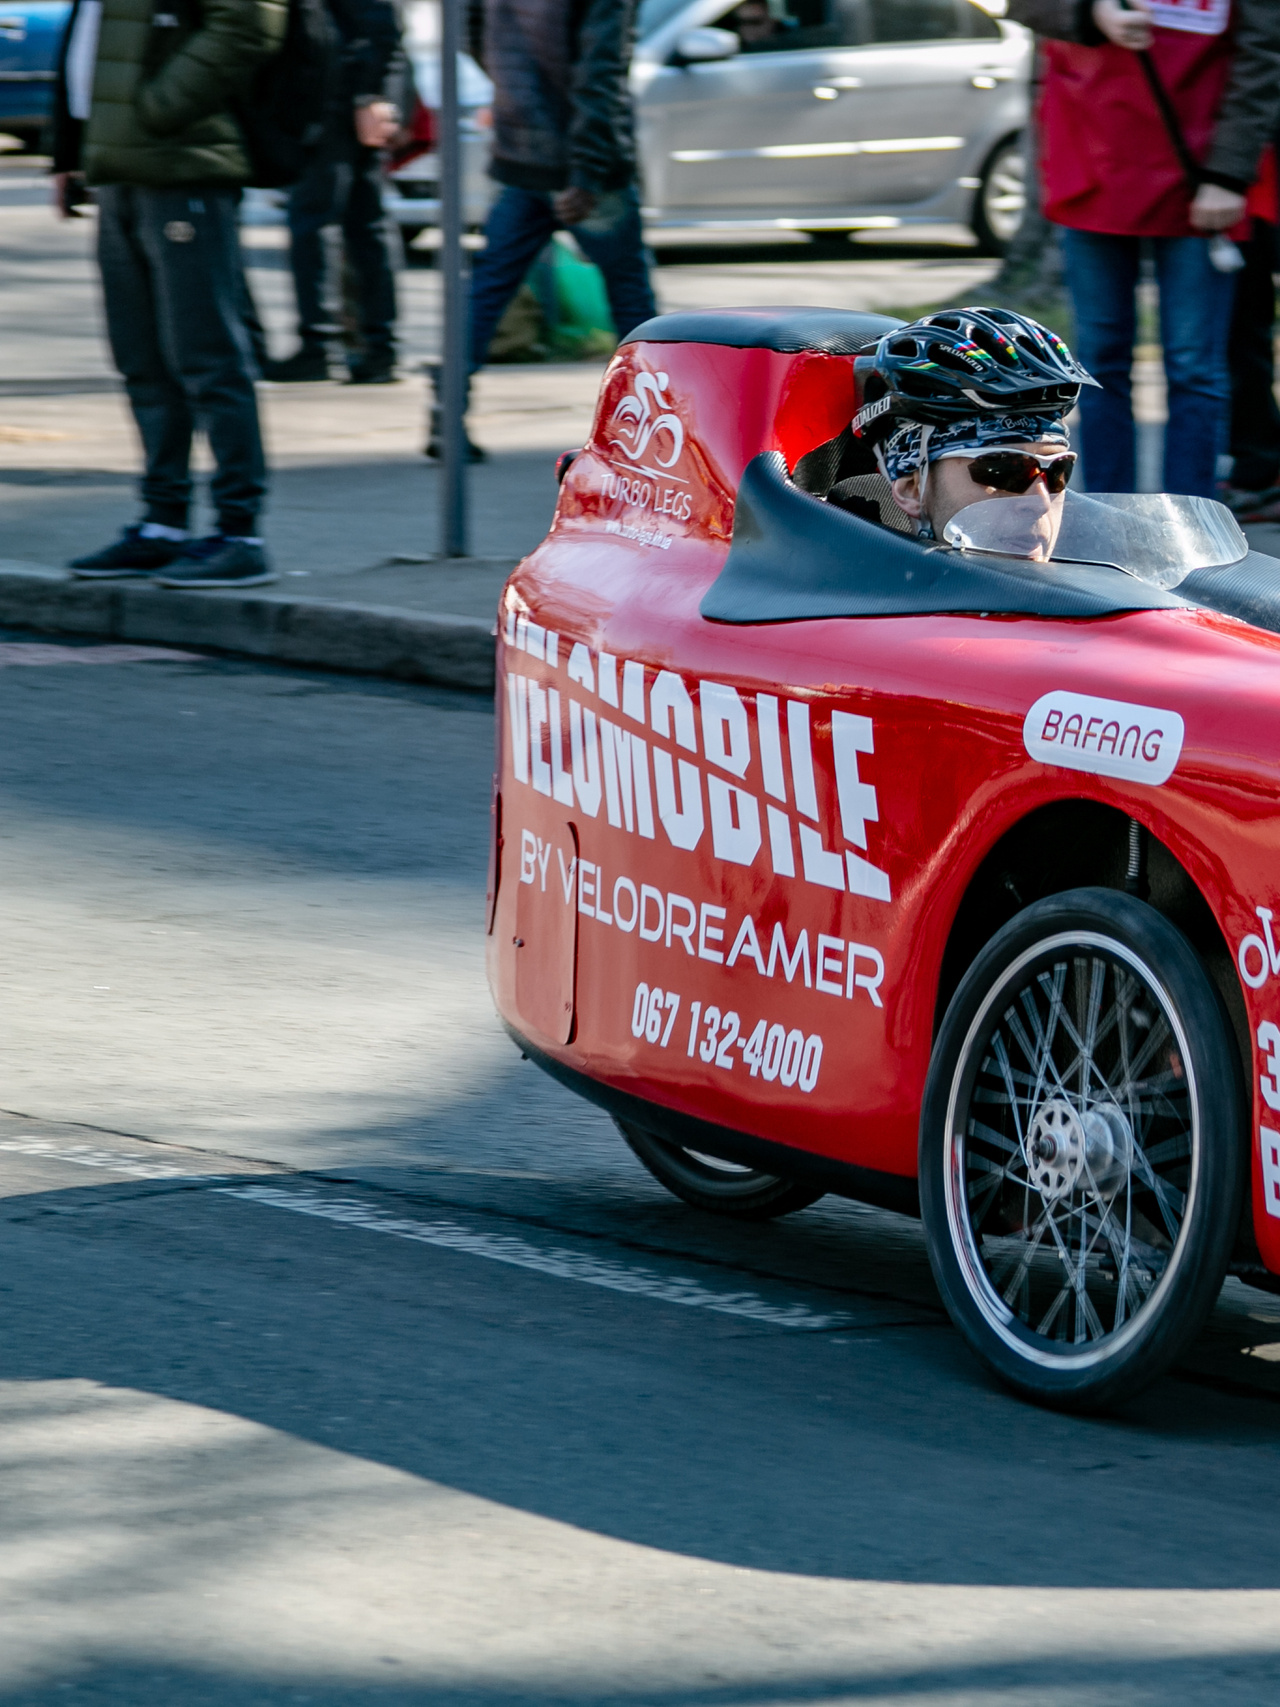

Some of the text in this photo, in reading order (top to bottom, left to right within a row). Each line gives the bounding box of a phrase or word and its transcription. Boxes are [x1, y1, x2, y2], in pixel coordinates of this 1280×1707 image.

[939, 343, 984, 372] SPECIALIZED
[600, 473, 692, 521] TURBO LEGS
[506, 610, 892, 903] VELOMOBILE
[1041, 709, 1164, 762] BAFANG
[520, 828, 884, 1008] BY VELODREAMER
[631, 982, 823, 1093] 067 132-4000
